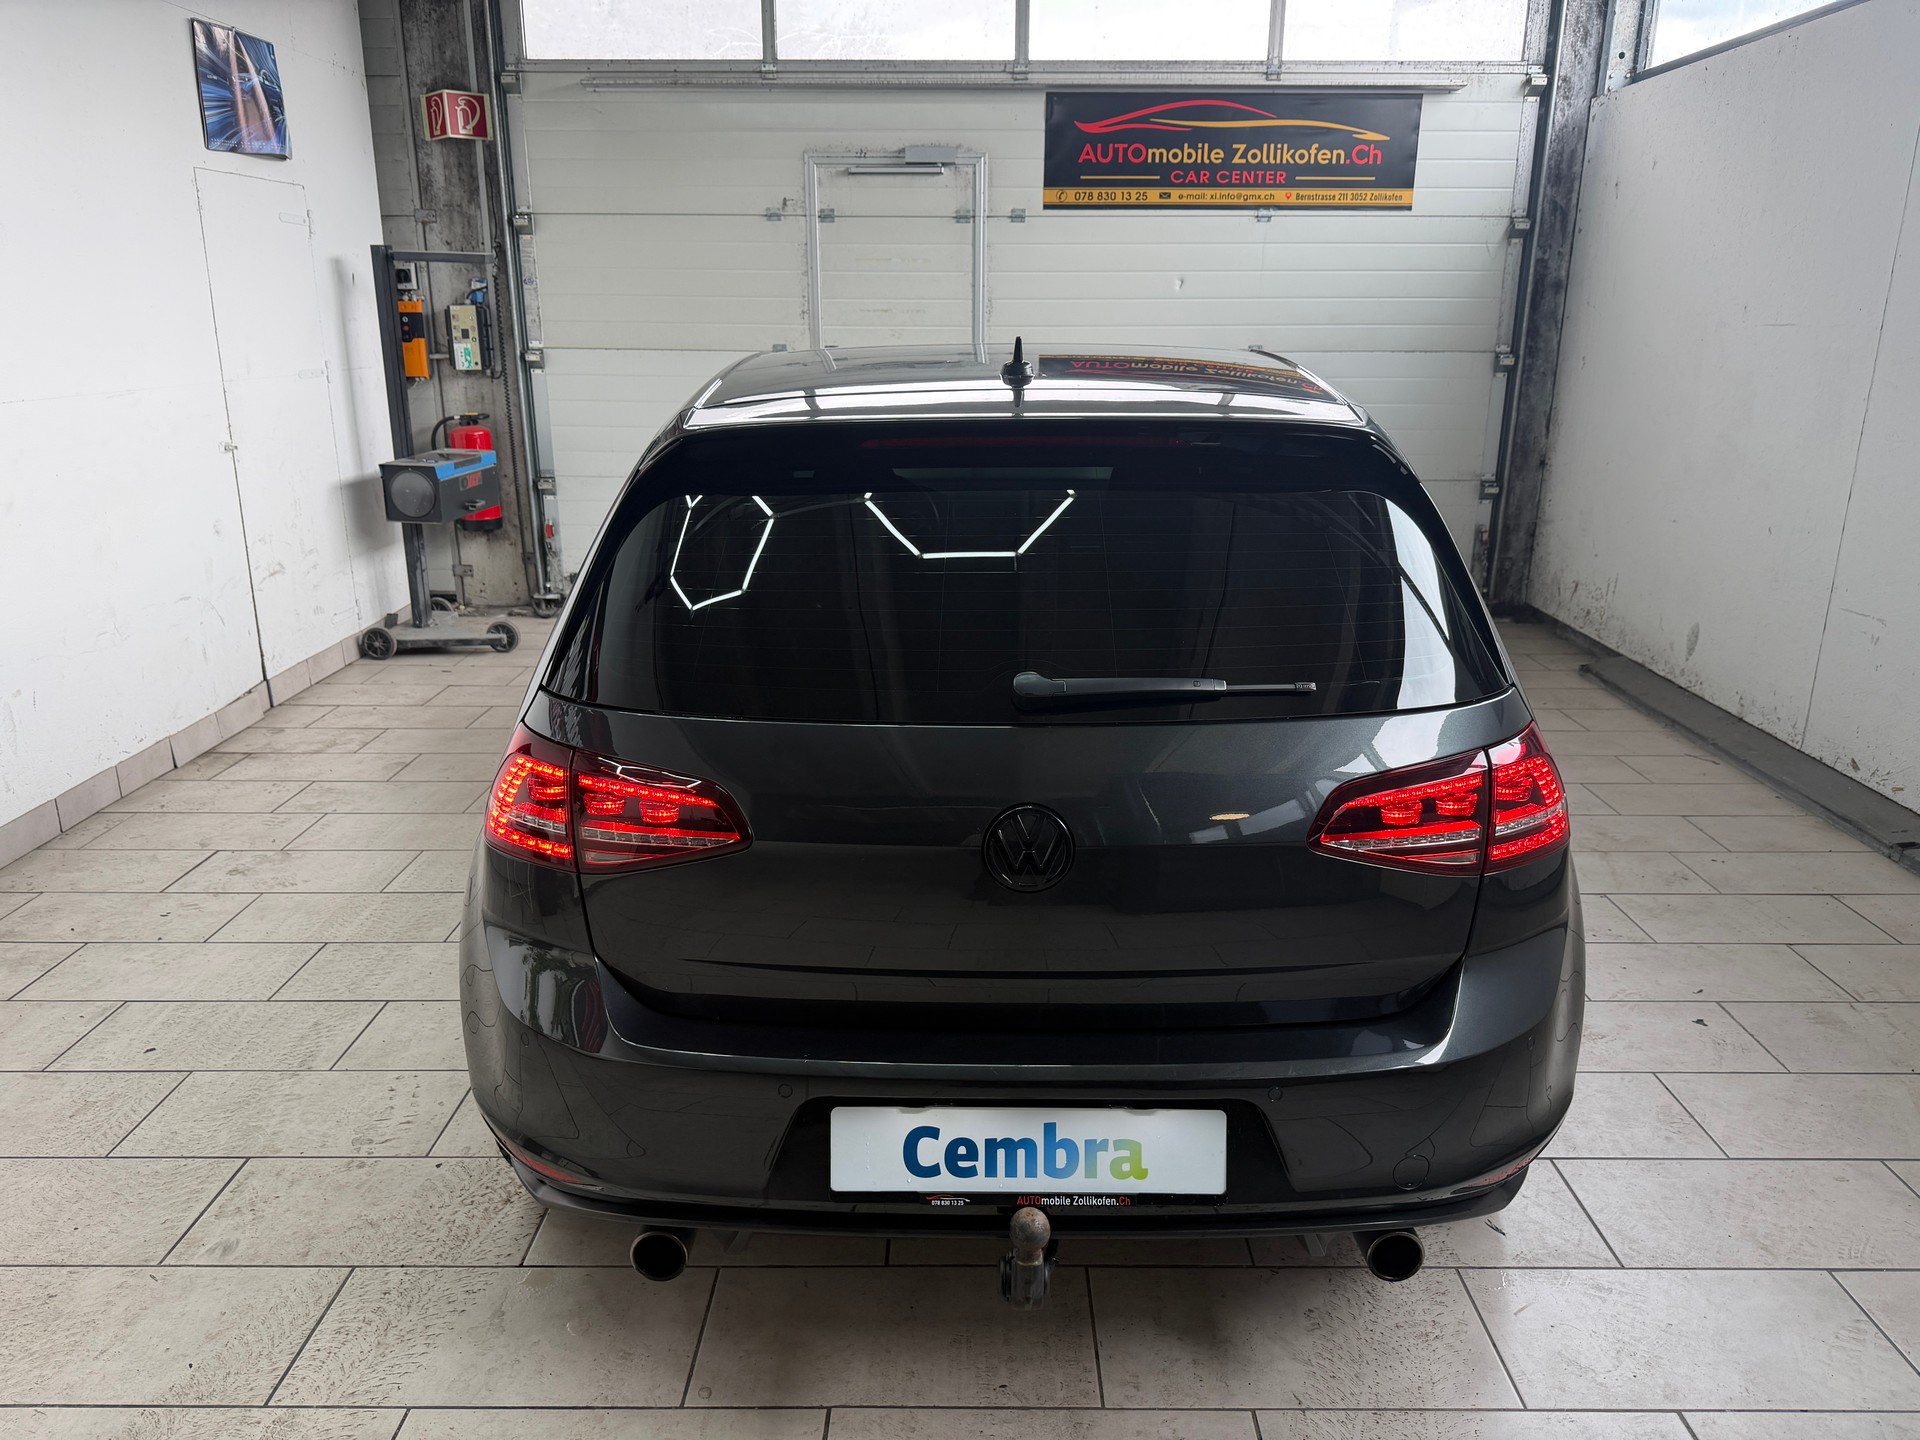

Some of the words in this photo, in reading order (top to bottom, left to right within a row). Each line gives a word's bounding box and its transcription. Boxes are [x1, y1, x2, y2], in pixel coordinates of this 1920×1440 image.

[1078, 143, 1224, 164] AUTOmobile
[1232, 143, 1382, 165] Zollikofen.Ch
[1170, 170, 1210, 184] CAR
[1216, 170, 1286, 184] CENTER
[1074, 191, 1094, 201] 078
[1097, 191, 1117, 201] 830
[1121, 191, 1132, 201] 13
[1135, 191, 1148, 201] 25
[1178, 192, 1208, 201] e-mail:
[1295, 192, 1336, 201] Bernstrasse
[1338, 192, 1348, 201] 211
[1350, 192, 1368, 201] 3052
[1369, 192, 1403, 202] Zollikofen
[902, 1122, 1149, 1180] Cembra
[1017, 1196, 1070, 1206] AUTOmobile
[1073, 1196, 1130, 1206] Zollikofen.Ch
